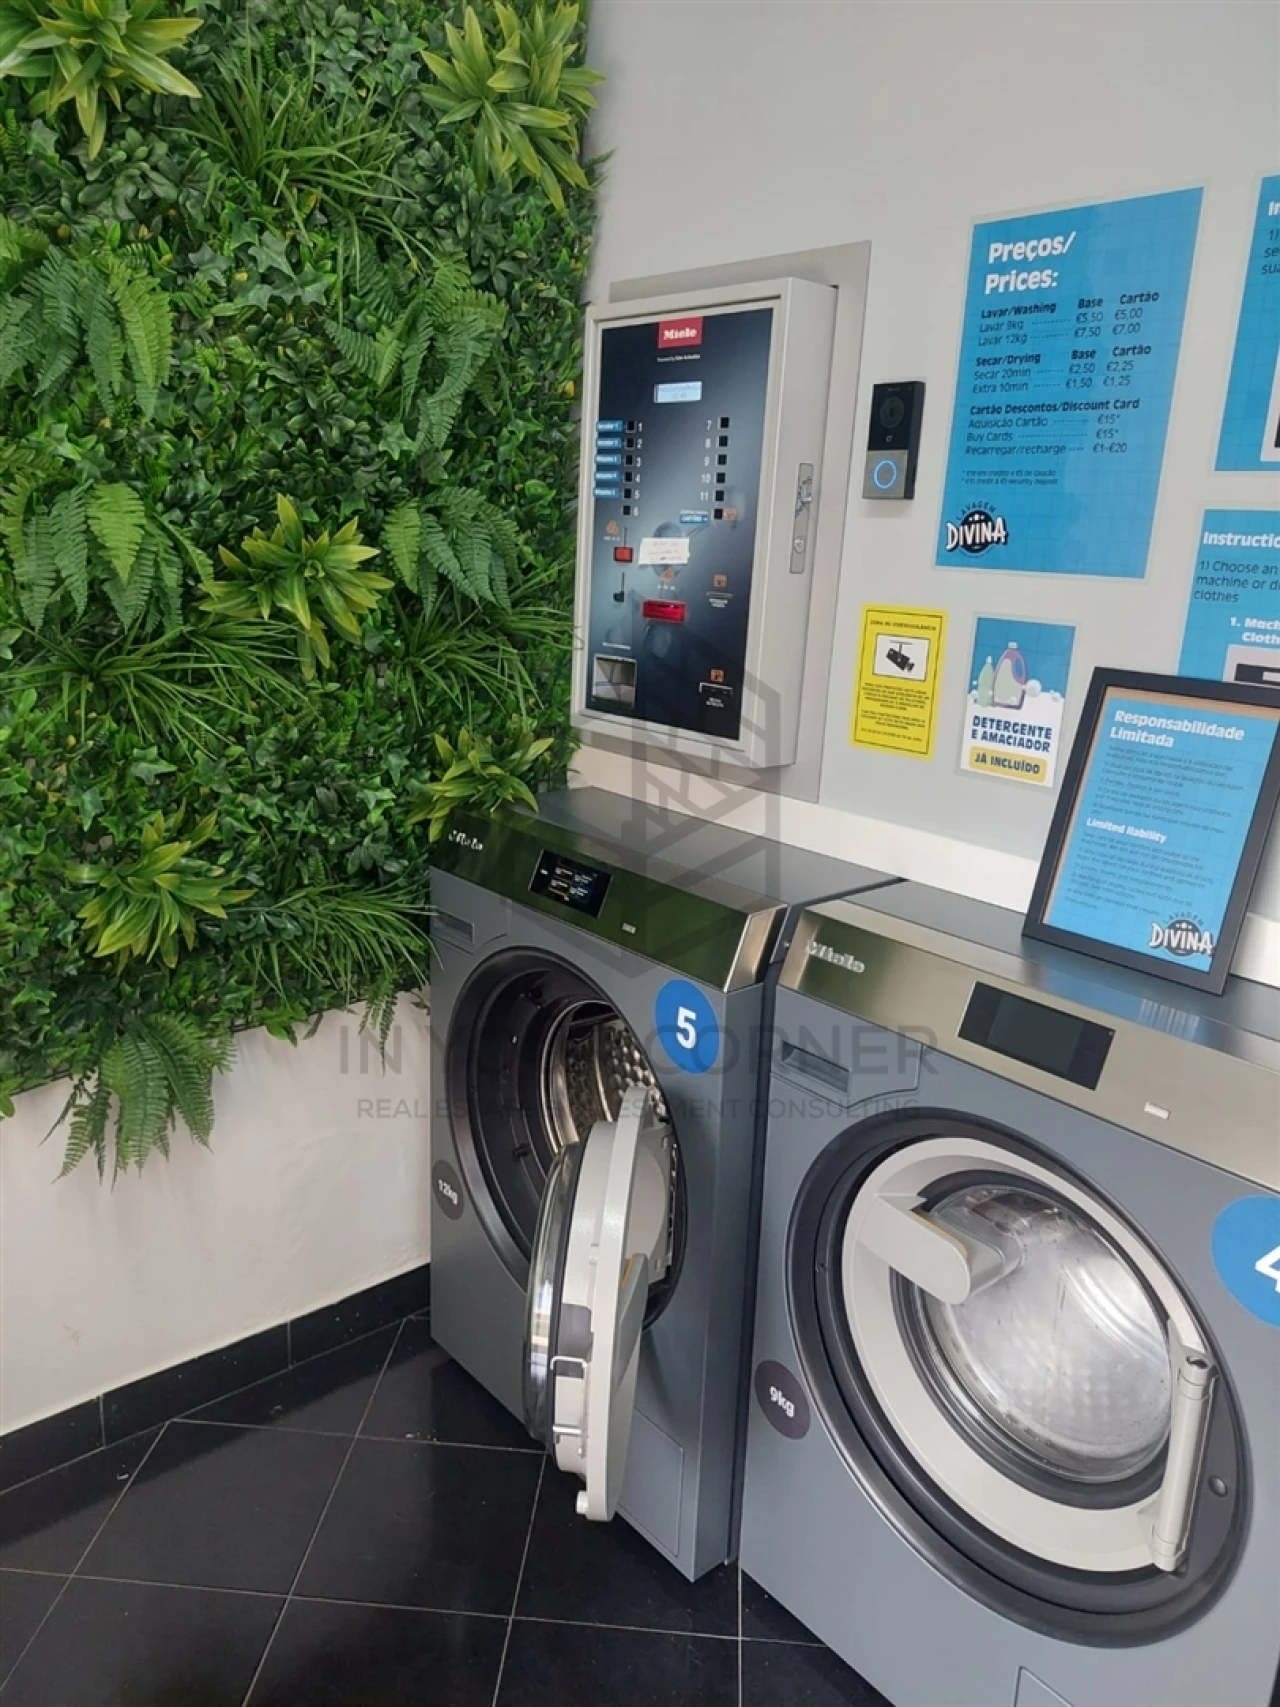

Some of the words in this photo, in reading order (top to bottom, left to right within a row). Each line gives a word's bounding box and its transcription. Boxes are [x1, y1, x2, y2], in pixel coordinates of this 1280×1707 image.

[988, 231, 1077, 264] Preços/
[984, 268, 1060, 295] Prices:
[981, 302, 1056, 319] Lavar/Washing
[1077, 298, 1103, 310] Base
[1120, 291, 1160, 305] Cartão
[663, 327, 697, 341] Miele
[979, 321, 1003, 333] Lavar
[1006, 319, 1024, 331] 9kg
[978, 335, 1002, 347] Lavar
[1006, 332, 1027, 346] 12kg
[976, 353, 1041, 368] Secar/Drying
[1071, 349, 1097, 360] Base
[1112, 344, 1152, 358] Cartão
[974, 370, 999, 381] Secar
[1001, 367, 1031, 379] 20min
[972, 384, 997, 394] Extra
[999, 381, 1029, 393] 10min
[969, 404, 1002, 416] Cartão
[1004, 399, 1110, 414] Descontos/Discount
[1113, 398, 1140, 409] Card
[968, 418, 1013, 430] Aquisição
[1016, 415, 1048, 427] Cartão
[966, 431, 985, 443] Buy
[986, 431, 1014, 442] Cards
[965, 443, 1066, 456] Recarregar/recharge
[701, 473, 711, 483] 10
[700, 491, 709, 501] 11
[945, 515, 1008, 552] DIVINA
[1200, 560, 1209, 571] 1)
[1212, 560, 1260, 575] Choose
[1262, 564, 1278, 575] an
[1196, 574, 1248, 589] machine
[1252, 579, 1266, 590] or
[1194, 590, 1239, 603] clothes
[1230, 617, 1241, 627] 1.
[972, 715, 1052, 740] DETERGENTE
[1114, 710, 1245, 741] Responsabilidade
[971, 729, 978, 739] E
[980, 731, 1050, 752] AMACIADOR
[1110, 727, 1175, 748] Limitada
[975, 753, 987, 764] JÁ
[990, 756, 1040, 774] INCLUÍDO
[1086, 817, 1126, 834] Limited
[1126, 825, 1168, 844] liability
[1148, 922, 1214, 955] DIVINA
[676, 1006, 697, 1049] 5
[769, 1385, 796, 1419] 9kg
